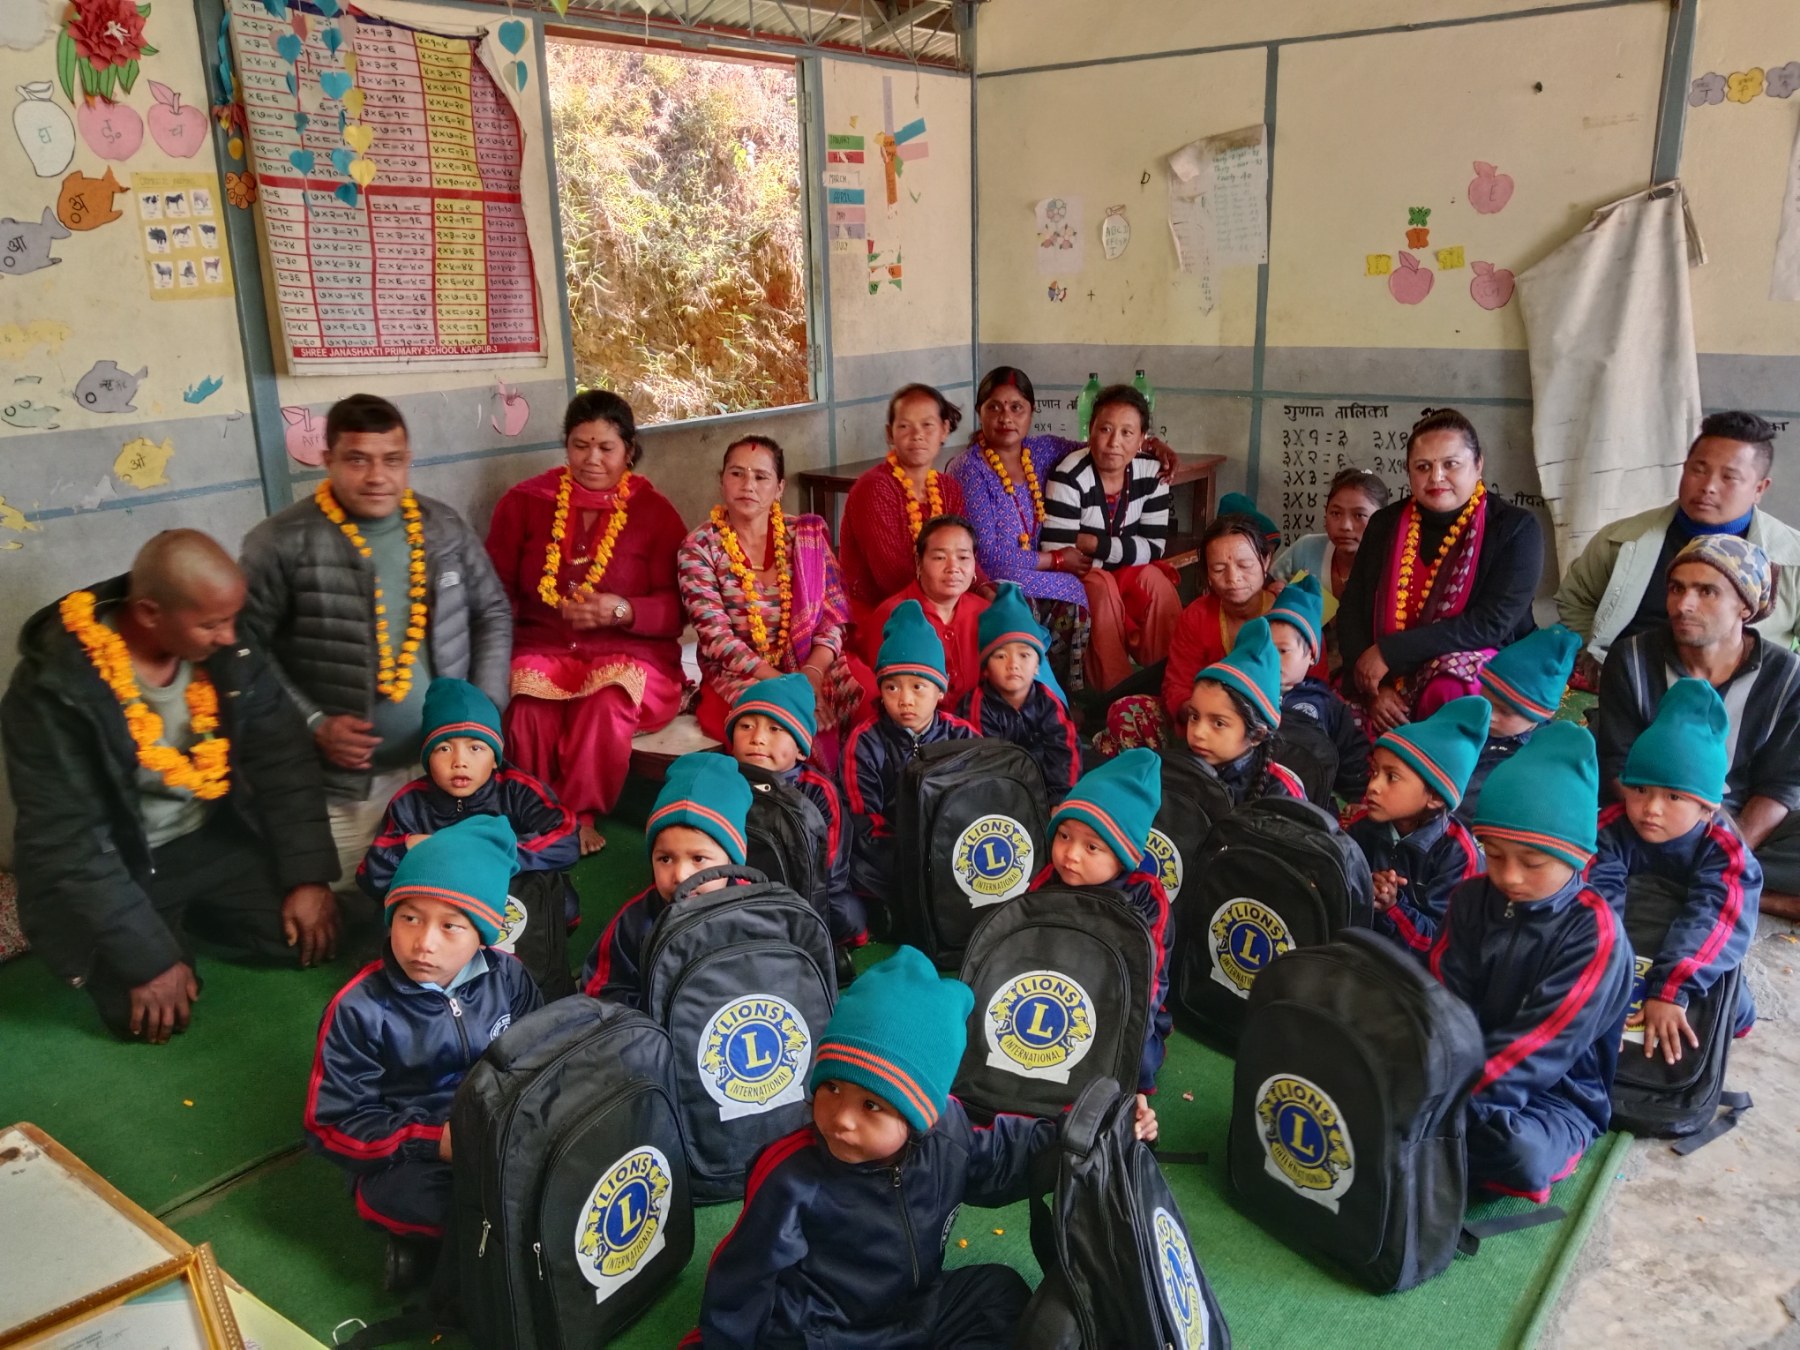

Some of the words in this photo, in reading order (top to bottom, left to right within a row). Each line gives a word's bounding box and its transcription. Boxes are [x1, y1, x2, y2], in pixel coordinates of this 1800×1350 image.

[300, 348, 328, 357] SHREE
[329, 347, 383, 356] JANASHAKTI
[385, 346, 423, 355] PRIMARY
[424, 345, 460, 355] SCHOOL
[1335, 402, 1389, 419] तालिका
[967, 821, 1011, 842] LIONS
[982, 842, 1007, 871] L
[976, 872, 1019, 891] INTERNATIONAL
[1234, 905, 1281, 937] LIONS
[1239, 928, 1261, 965] L
[1222, 957, 1253, 987] INTERNATI
[1020, 978, 1077, 1004] LIONS
[720, 1002, 780, 1031] LIONS
[1026, 1002, 1054, 1039] L
[741, 1031, 773, 1070] L
[1004, 1039, 1062, 1063] INTERNATIONAL
[729, 1071, 789, 1098] INTERNATIONAL
[1277, 1082, 1333, 1122] LIONS
[1289, 1112, 1315, 1158] L
[599, 1157, 649, 1206] LIONS
[617, 1193, 642, 1238] L
[605, 1226, 654, 1270] INTERNATIONAL
